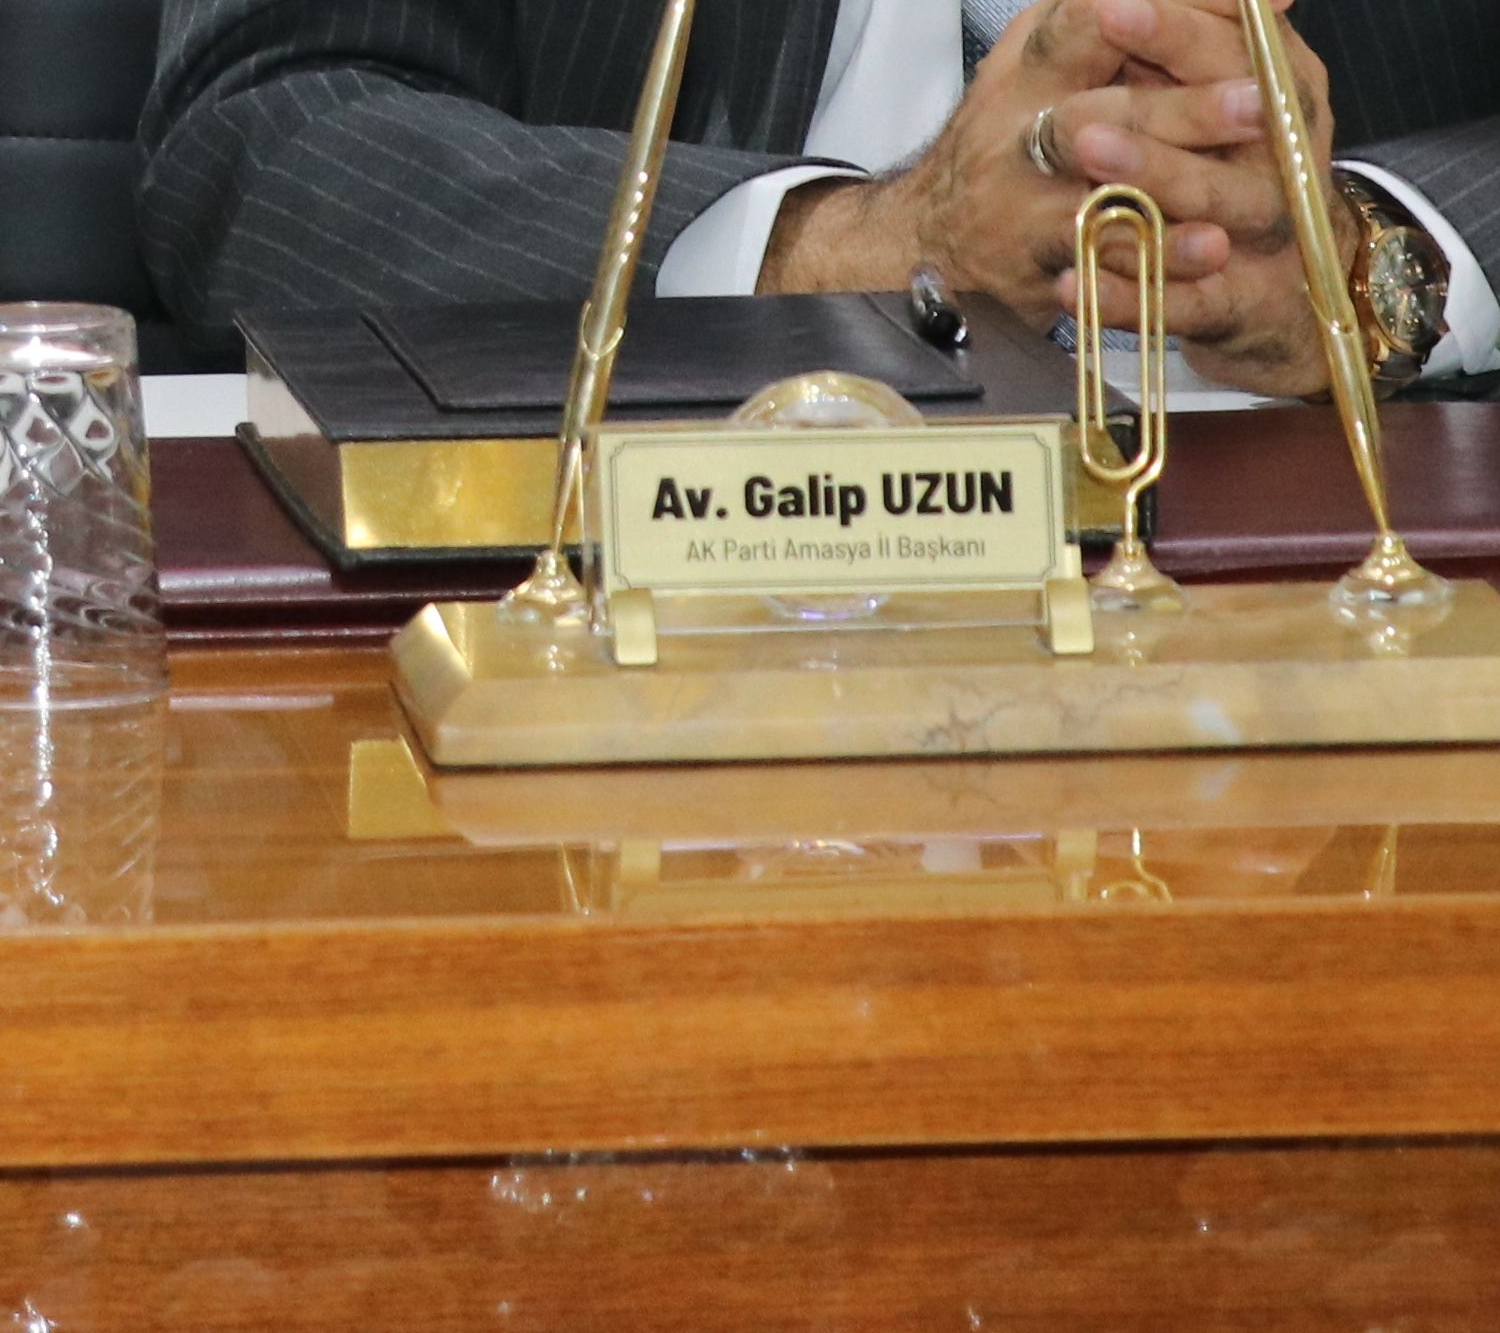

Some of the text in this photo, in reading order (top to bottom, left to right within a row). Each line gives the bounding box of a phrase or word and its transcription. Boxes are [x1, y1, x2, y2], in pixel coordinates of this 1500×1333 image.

[652, 470, 1015, 527] Av. Galip UZUN
[686, 539, 717, 563] AK
[723, 537, 778, 562] Parti
[784, 536, 872, 565] Amasya
[899, 533, 986, 565] Başkanı
